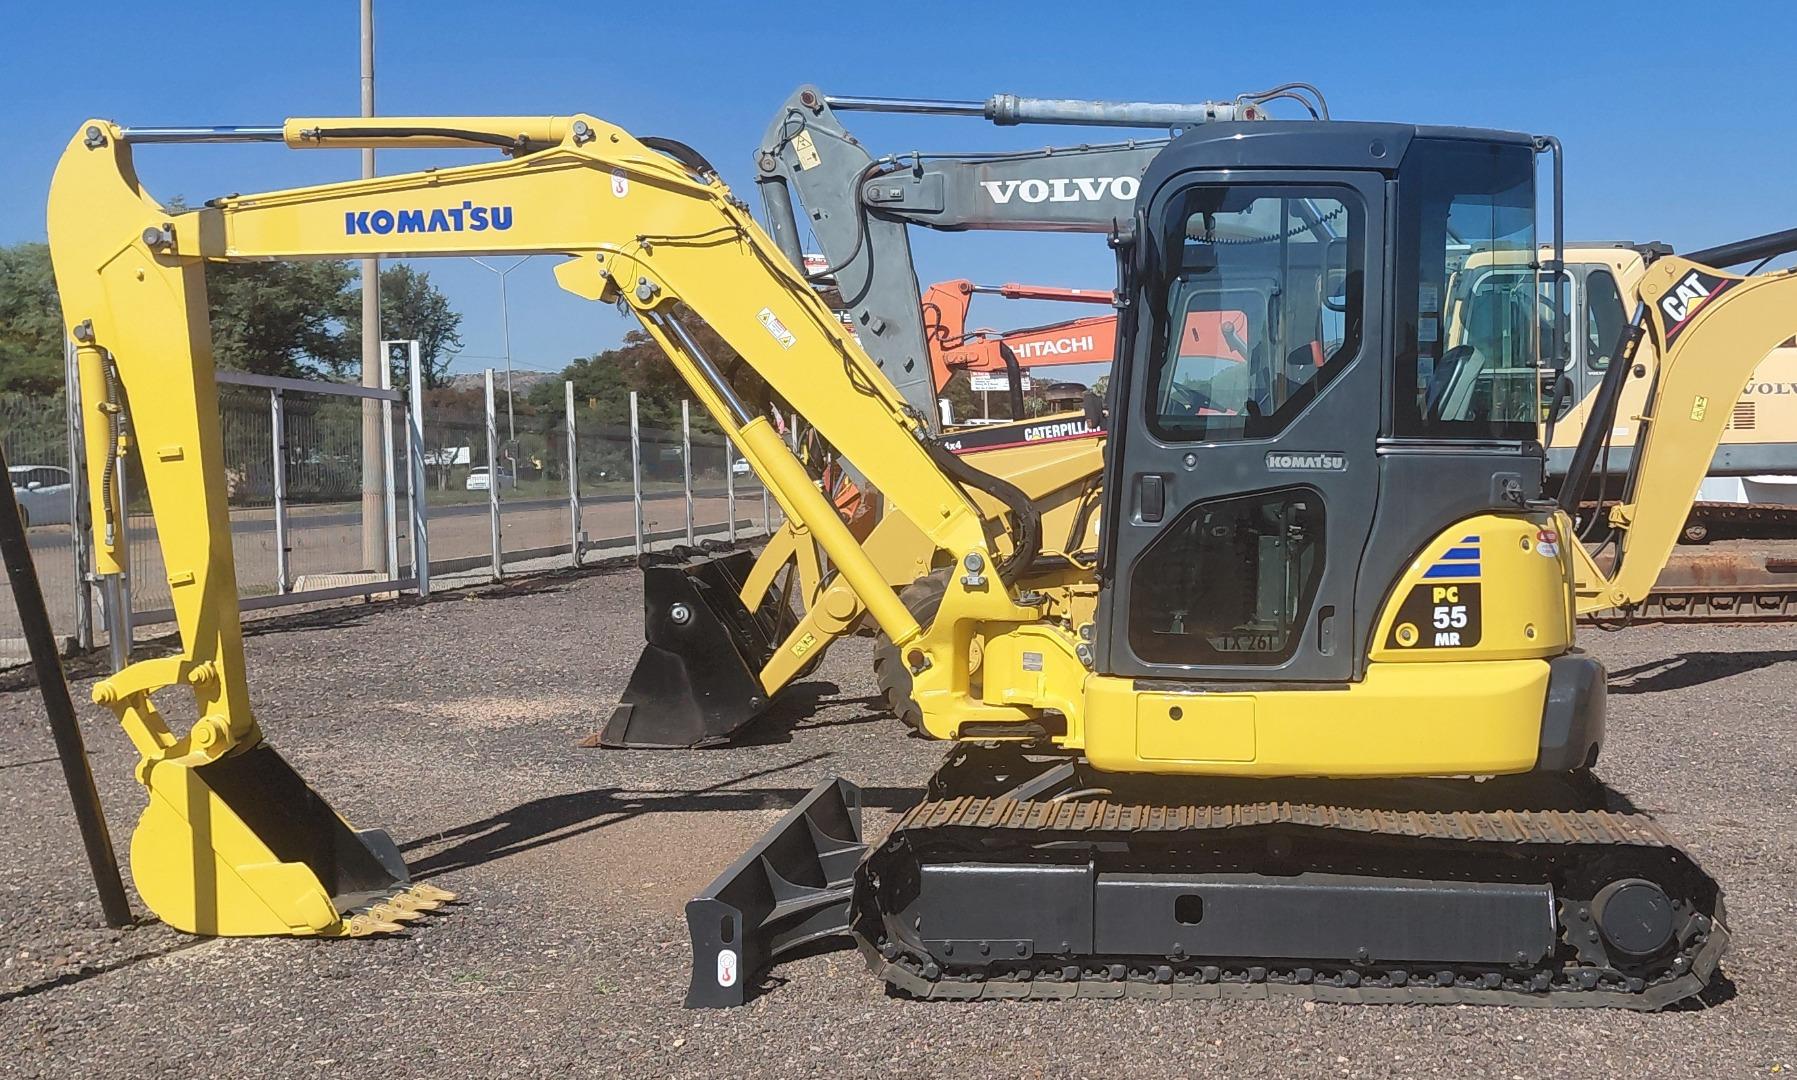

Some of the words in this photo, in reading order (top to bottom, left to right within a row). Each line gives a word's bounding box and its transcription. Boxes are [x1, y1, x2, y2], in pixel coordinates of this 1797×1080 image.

[979, 176, 1140, 204] VOLVO
[345, 200, 513, 236] KOMATSU
[1661, 272, 1711, 322] CAT
[1010, 336, 1095, 358] HITACHI
[1269, 454, 1343, 469] KOMATSU
[1432, 586, 1459, 604] PC
[1432, 605, 1468, 629] 55
[1247, 633, 1273, 651] 261
[1434, 632, 1461, 647] MR
